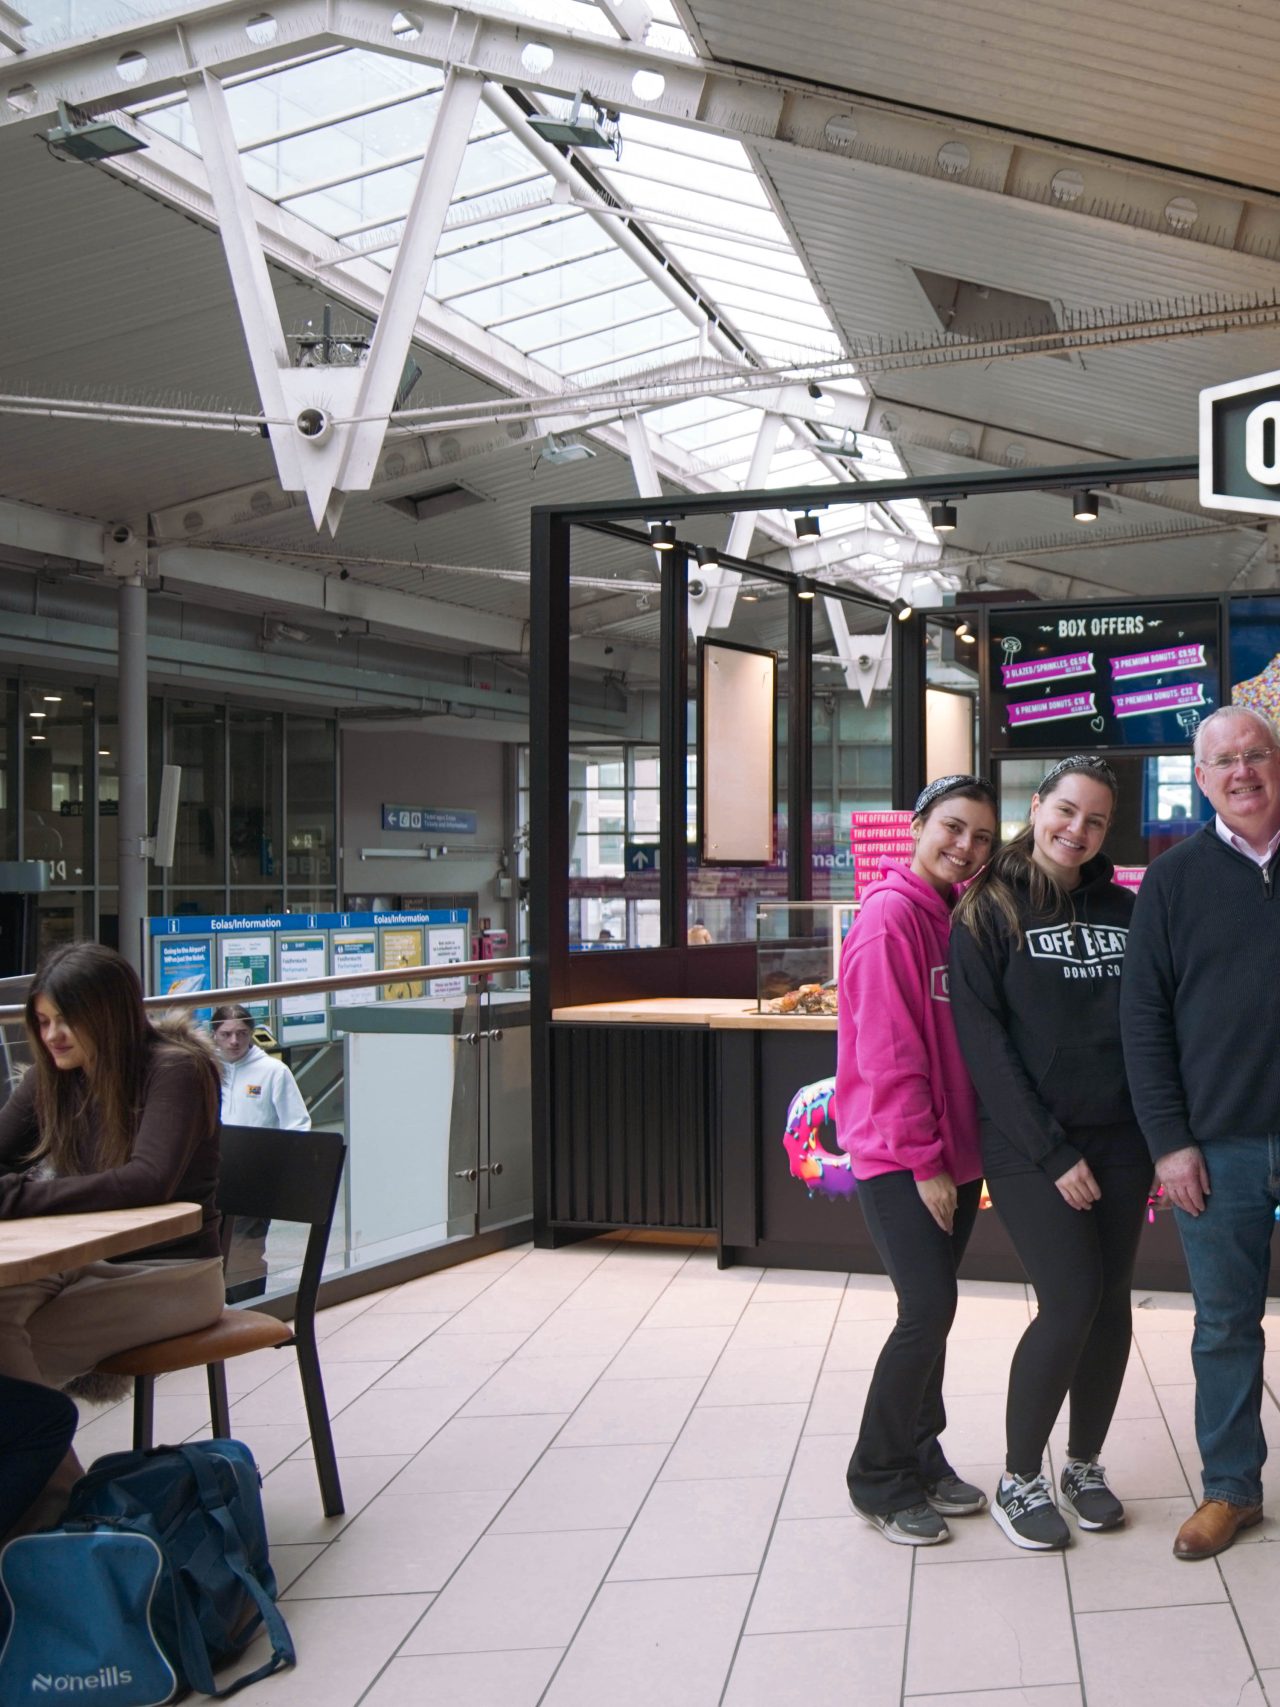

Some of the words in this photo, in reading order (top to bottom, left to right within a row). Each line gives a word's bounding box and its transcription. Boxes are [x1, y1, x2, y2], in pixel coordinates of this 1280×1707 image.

[1058, 619, 1087, 638] BOX
[1091, 616, 1144, 636] OFFERS
[1121, 656, 1150, 668] PREMIUM
[855, 814, 868, 823] THE
[869, 814, 898, 823] OFFBEAT
[898, 813, 913, 823] DOZ
[854, 829, 866, 839] THE
[867, 828, 896, 838] OFFBEAT
[896, 828, 912, 838] DOZ
[854, 843, 867, 852] THE
[867, 843, 896, 852] OFFBEAT
[896, 843, 914, 852] DOZE
[811, 849, 856, 868] mach
[858, 857, 871, 867] THE
[858, 871, 871, 881] THE
[211, 917, 281, 931] Eolas/Information
[373, 913, 430, 925] Eolas/Information
[1038, 929, 1076, 956] OFF
[1063, 965, 1103, 979] DONUT
